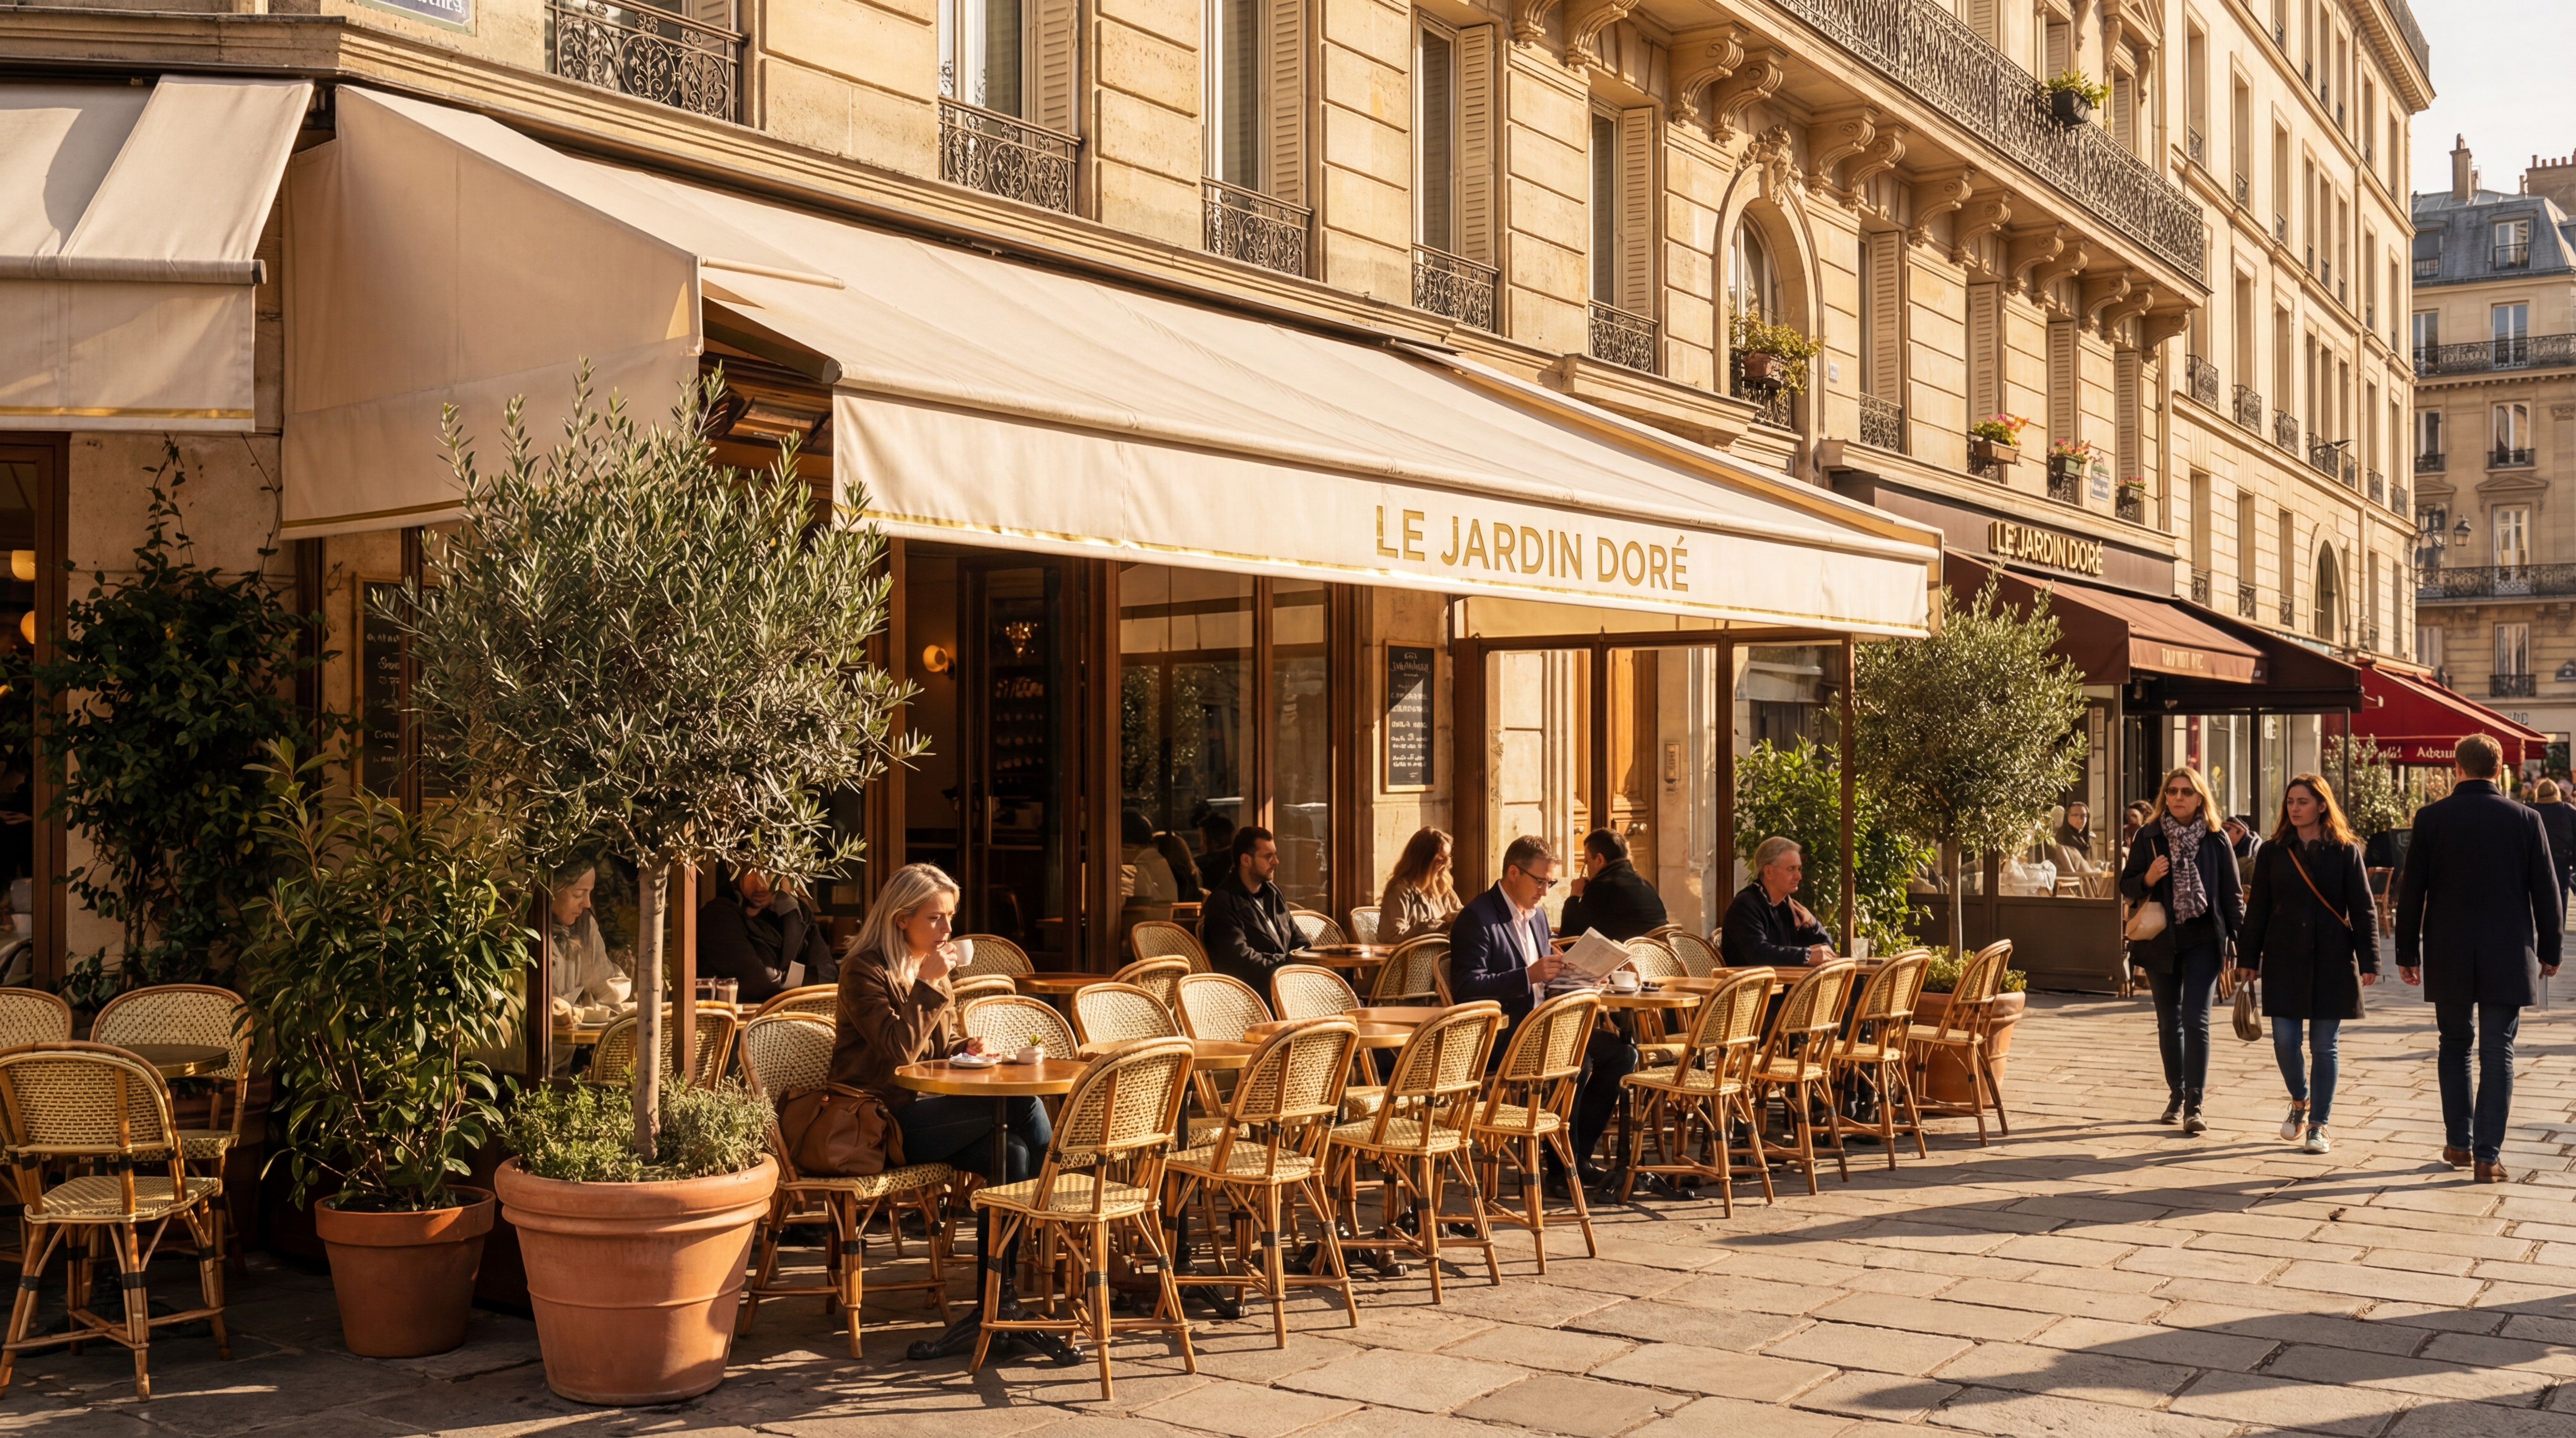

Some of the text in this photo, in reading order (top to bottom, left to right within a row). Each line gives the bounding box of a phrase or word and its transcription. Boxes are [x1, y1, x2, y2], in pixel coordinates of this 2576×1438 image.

[1376, 506, 1689, 592] LE JARDIN DORÉ
[1992, 520, 2103, 575] LE JARDIN DORÉ
